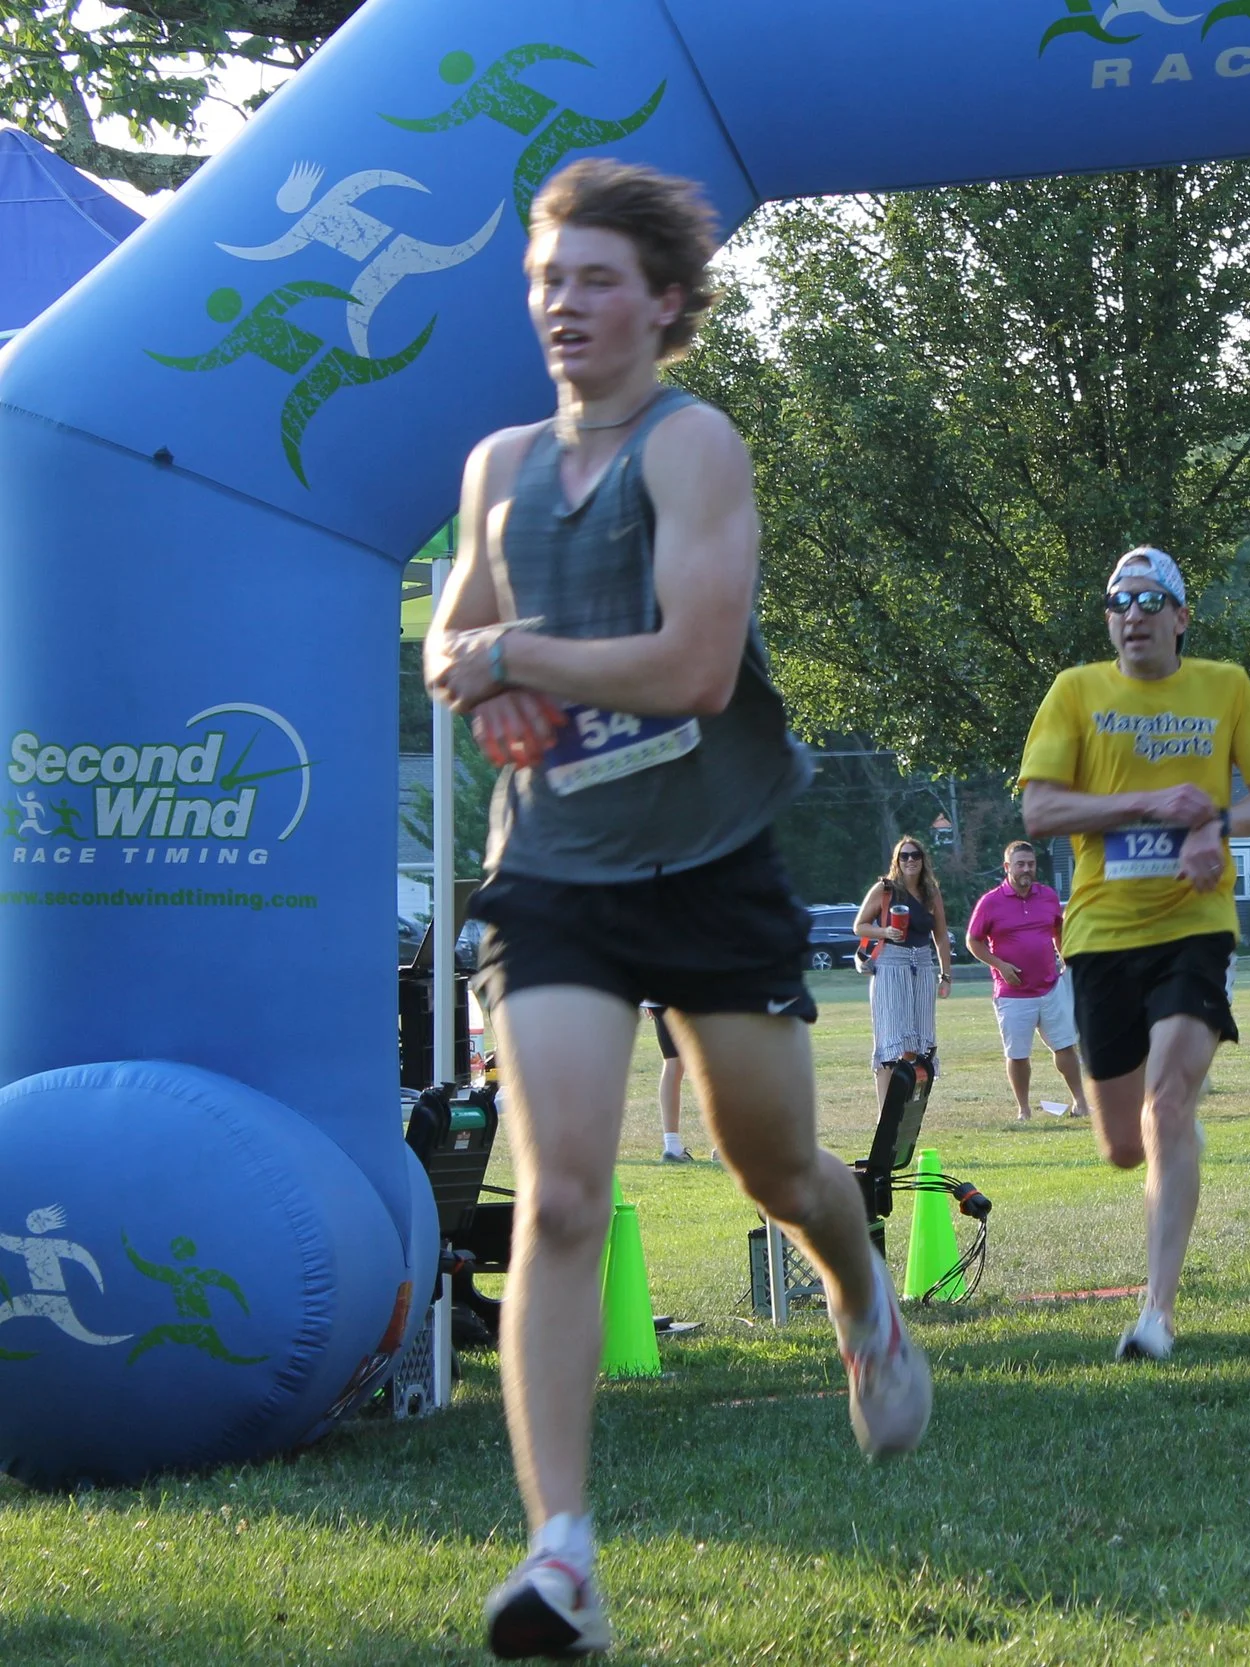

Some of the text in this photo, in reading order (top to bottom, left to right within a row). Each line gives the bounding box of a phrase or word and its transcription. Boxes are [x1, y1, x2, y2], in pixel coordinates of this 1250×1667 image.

[1093, 711, 1219, 736] Marathon
[7, 731, 227, 785] Second
[1135, 734, 1213, 763] Sports
[94, 787, 257, 839] Wind
[13, 847, 268, 865] RACE TIMING
[1125, 832, 1173, 859] 126
